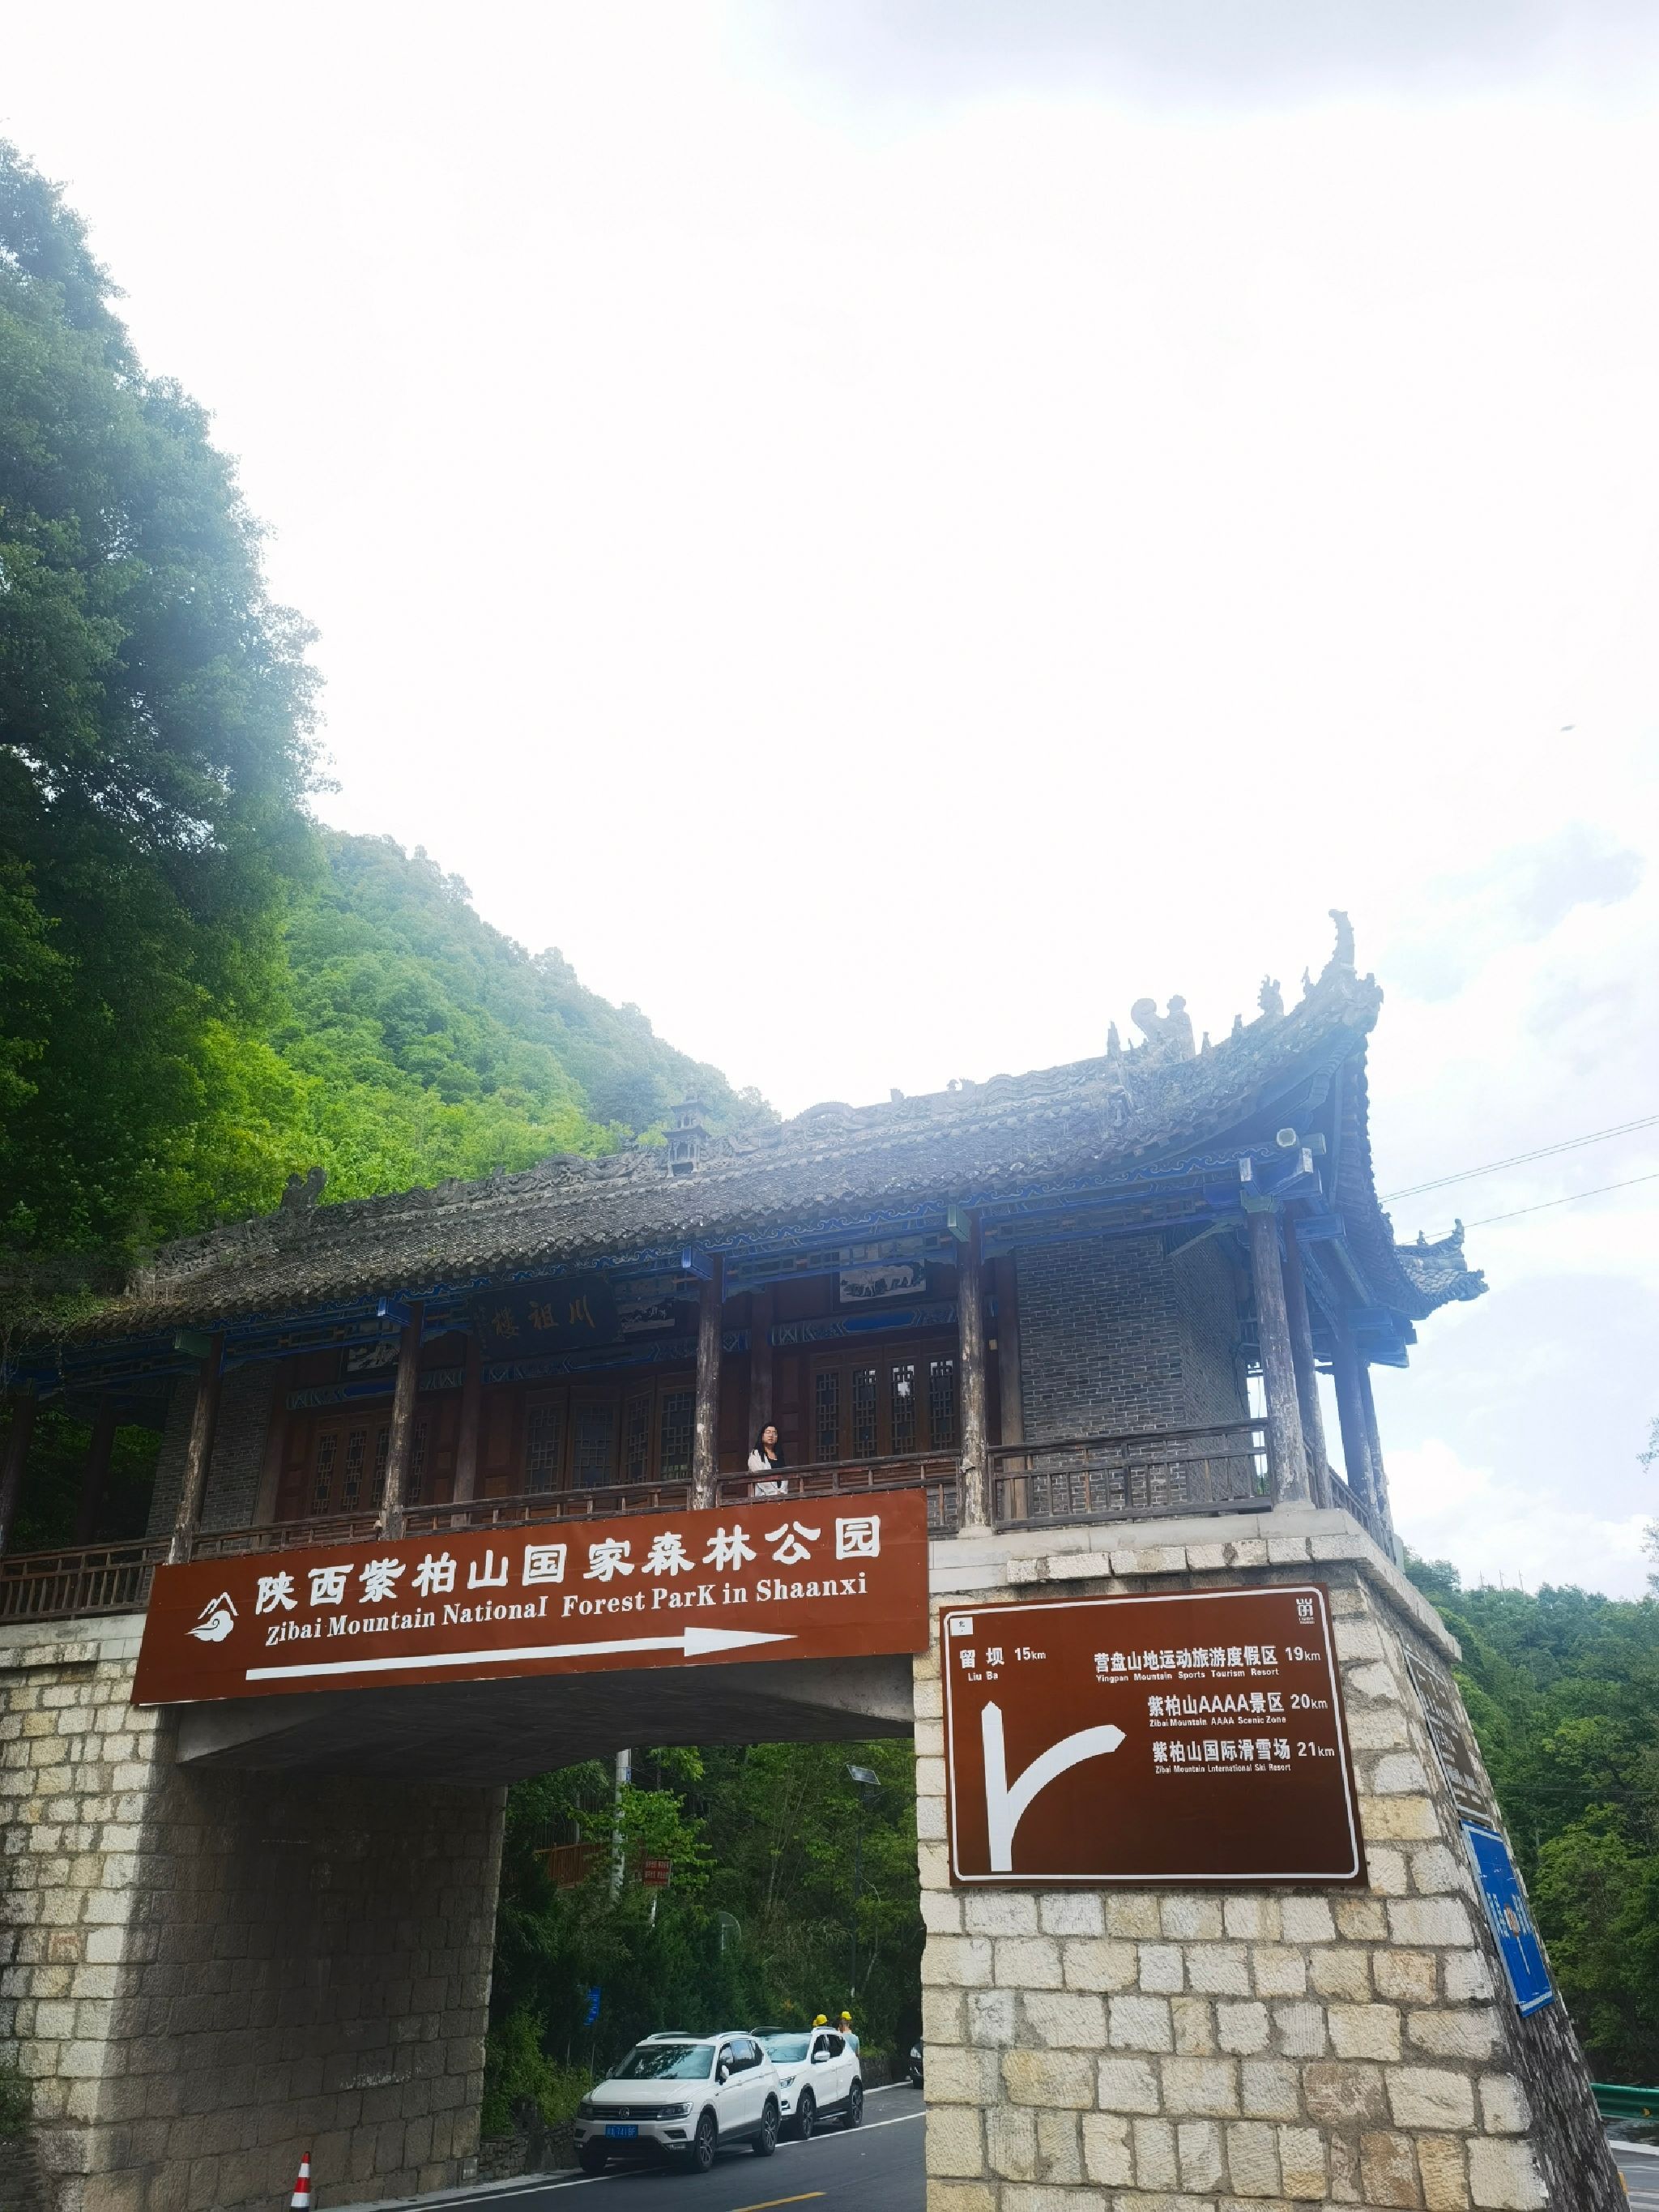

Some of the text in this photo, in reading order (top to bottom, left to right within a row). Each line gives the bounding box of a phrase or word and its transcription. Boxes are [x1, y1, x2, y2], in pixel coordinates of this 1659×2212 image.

[256, 1516, 881, 1613] 陕西紫柏山国家森林公园
[266, 1619, 321, 1646] Zibai
[327, 1608, 435, 1637] Mountain
[561, 1592, 645, 1617] Forest
[723, 1583, 748, 1604] in
[757, 1572, 866, 1601] Shaanxi
[959, 1646, 1047, 1669] 留坝 15km
[1094, 1645, 1321, 1672] 营盘山地运动旅游度假区 19km
[967, 1670, 999, 1681] Liu Ba
[1095, 1668, 1280, 1684] Yingpan Mountain Sports Tourism Resort
[1148, 1693, 1328, 1716] 紫柏山AAAA景区 20km
[1149, 1719, 1169, 1727] Zibai
[1168, 1717, 1207, 1727] Mountain
[1211, 1716, 1235, 1726] AAAA
[1237, 1715, 1265, 1724] Scenic
[1153, 1738, 1335, 1762] 紫柏山国际滑雪场 21km
[1155, 1765, 1171, 1774] Zibai
[1173, 1764, 1205, 1773] Mountain
[1269, 1763, 1291, 1771] Resort
